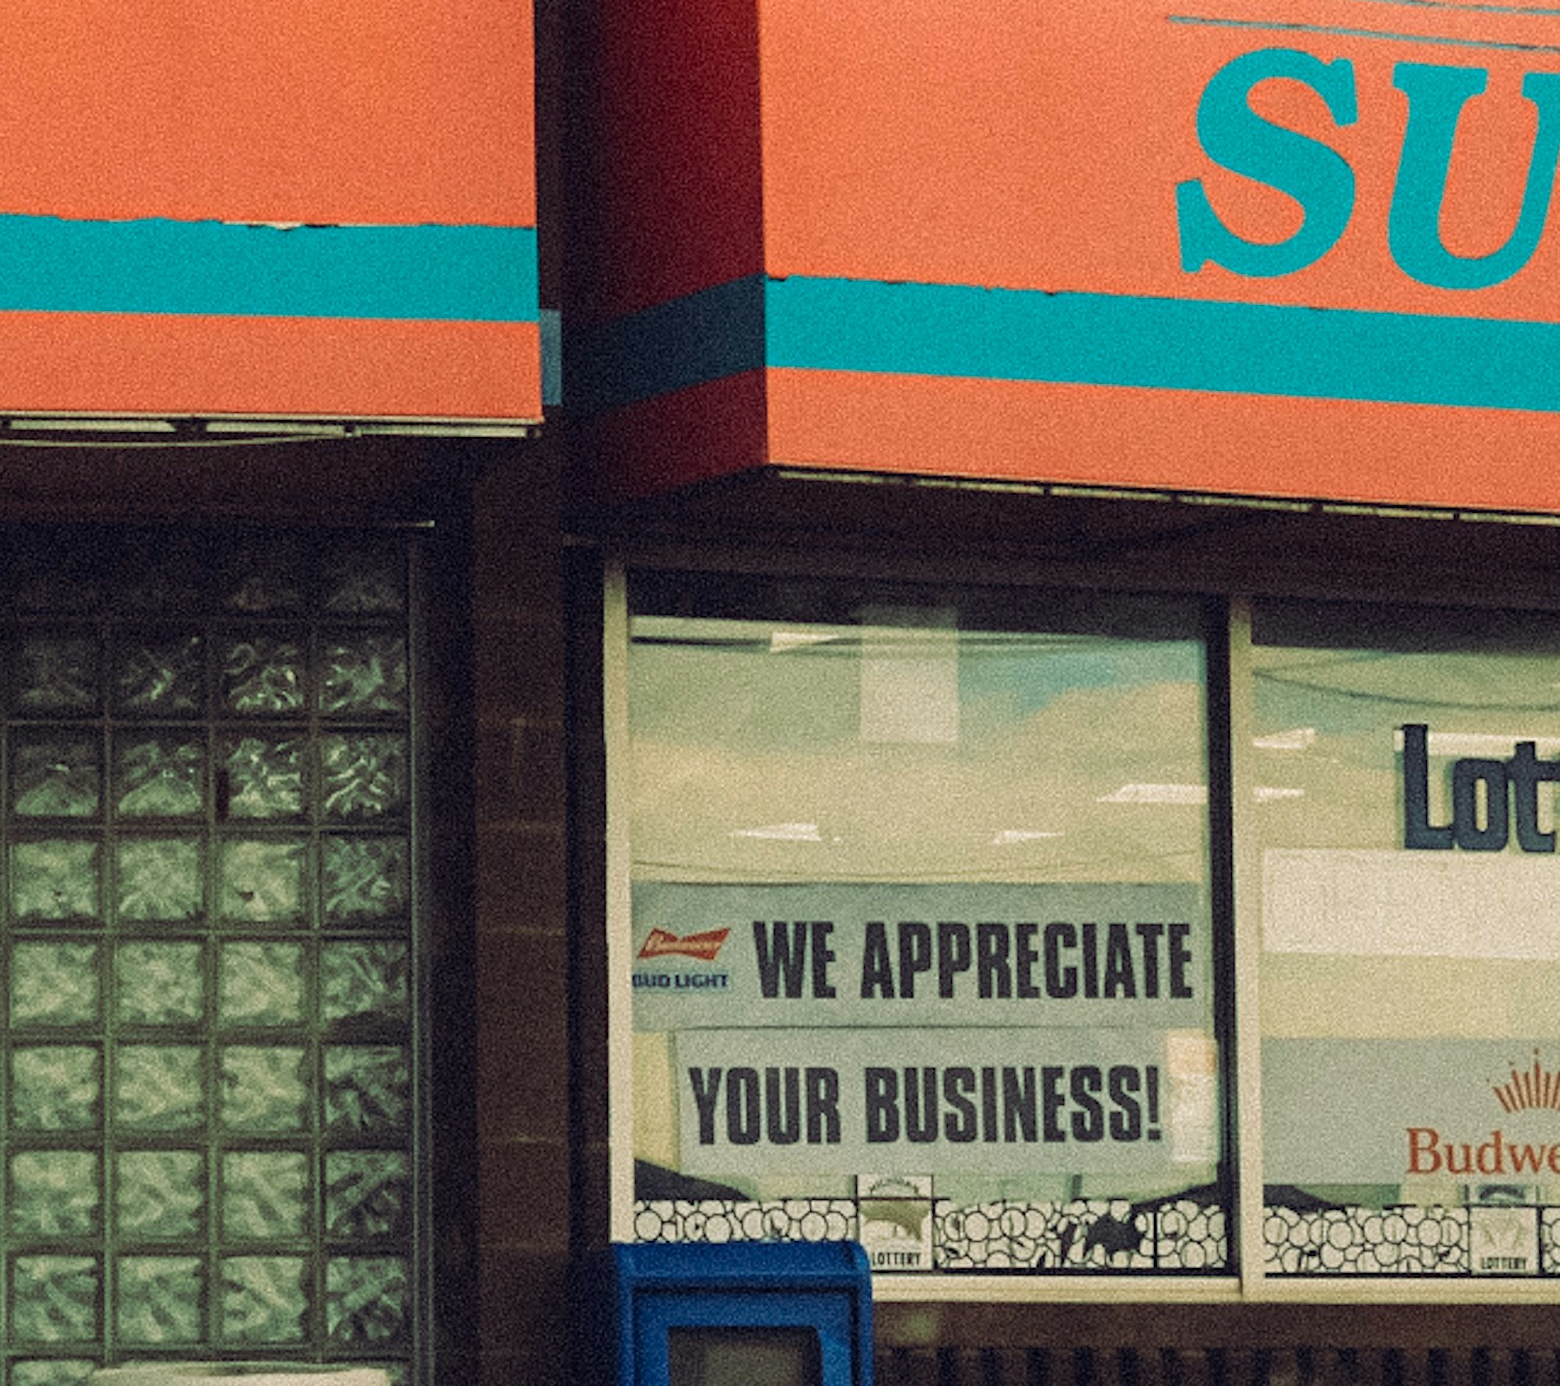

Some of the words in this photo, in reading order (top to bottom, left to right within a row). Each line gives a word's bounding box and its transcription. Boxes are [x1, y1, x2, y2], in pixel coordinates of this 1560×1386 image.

[675, 974, 728, 988] LIGHT
[753, 921, 836, 998] WE
[861, 922, 1192, 999] APPRECIATE
[688, 1068, 840, 1145] YOUR
[866, 1066, 1160, 1143] BUSINESS!
[871, 1252, 921, 1266] LOTTERY
